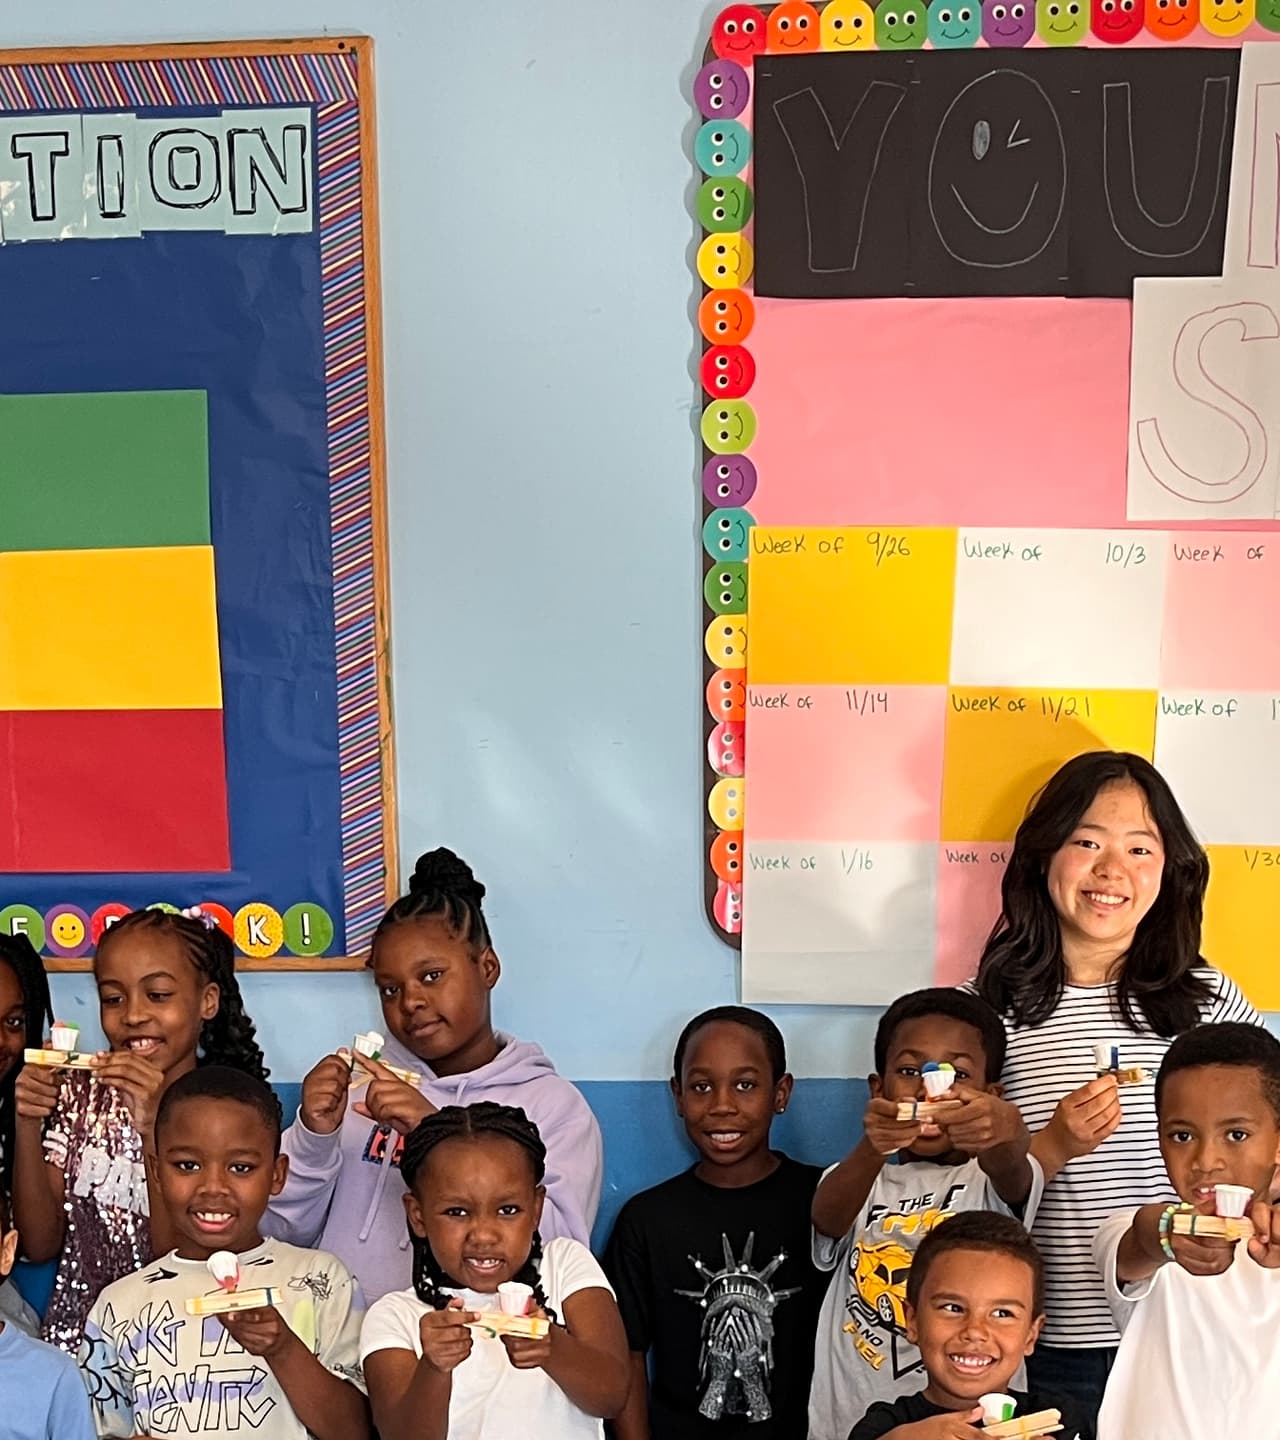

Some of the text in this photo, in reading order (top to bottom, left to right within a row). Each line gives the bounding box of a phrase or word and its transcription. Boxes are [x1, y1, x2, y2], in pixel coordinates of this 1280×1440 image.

[774, 69, 1230, 272] YOU
[818, 536, 844, 555] of
[866, 531, 911, 566] 9/26
[1020, 545, 1043, 561] of
[1105, 541, 1147, 567] 10/3
[1246, 544, 1265, 561] of
[797, 697, 814, 709] of
[845, 689, 888, 713] 11/14
[1001, 696, 1027, 713] of
[1040, 696, 1090, 721] 11/21
[1211, 698, 1238, 718] of
[791, 855, 817, 871] of
[840, 849, 874, 873] 1/16
[989, 850, 1008, 864] of
[898, 1191, 935, 1214] THE
